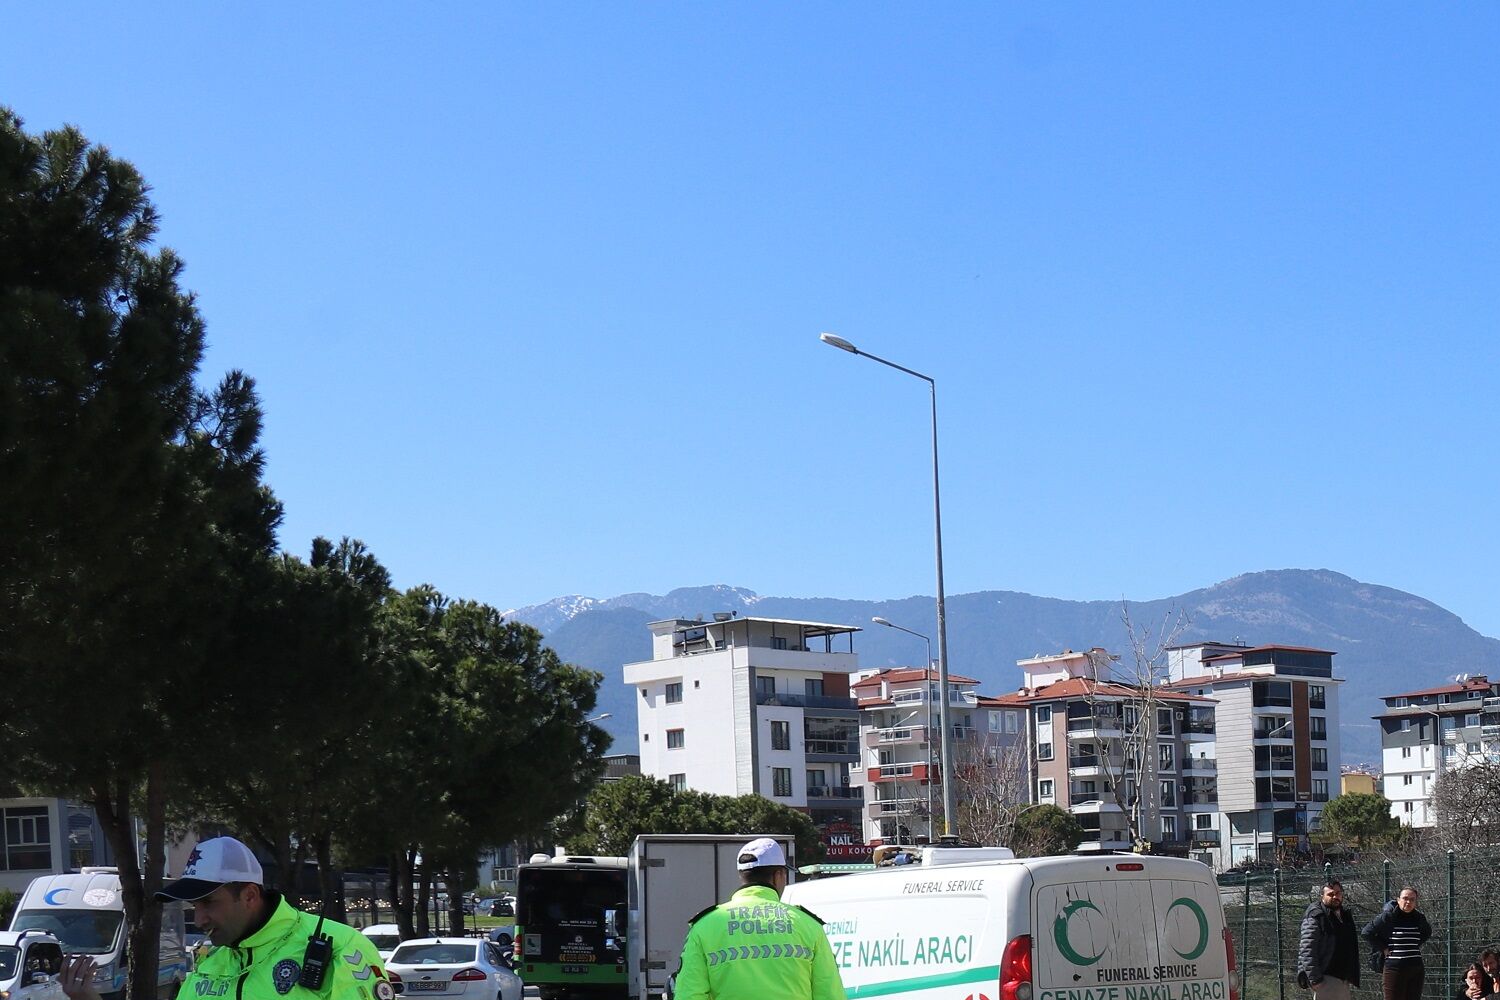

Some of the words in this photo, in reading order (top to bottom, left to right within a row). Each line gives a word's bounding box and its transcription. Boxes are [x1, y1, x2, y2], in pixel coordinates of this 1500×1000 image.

[830, 833, 853, 846] NAİL
[848, 846, 875, 855] KOKO
[903, 881, 943, 894] FUNERAL
[946, 879, 984, 892] SERVICE
[858, 932, 909, 968] NAKİL
[913, 935, 973, 966] ARACI
[1097, 967, 1150, 983] FUNERAL
[1153, 964, 1198, 979] SERVICE
[1181, 981, 1225, 1000] ARACI
